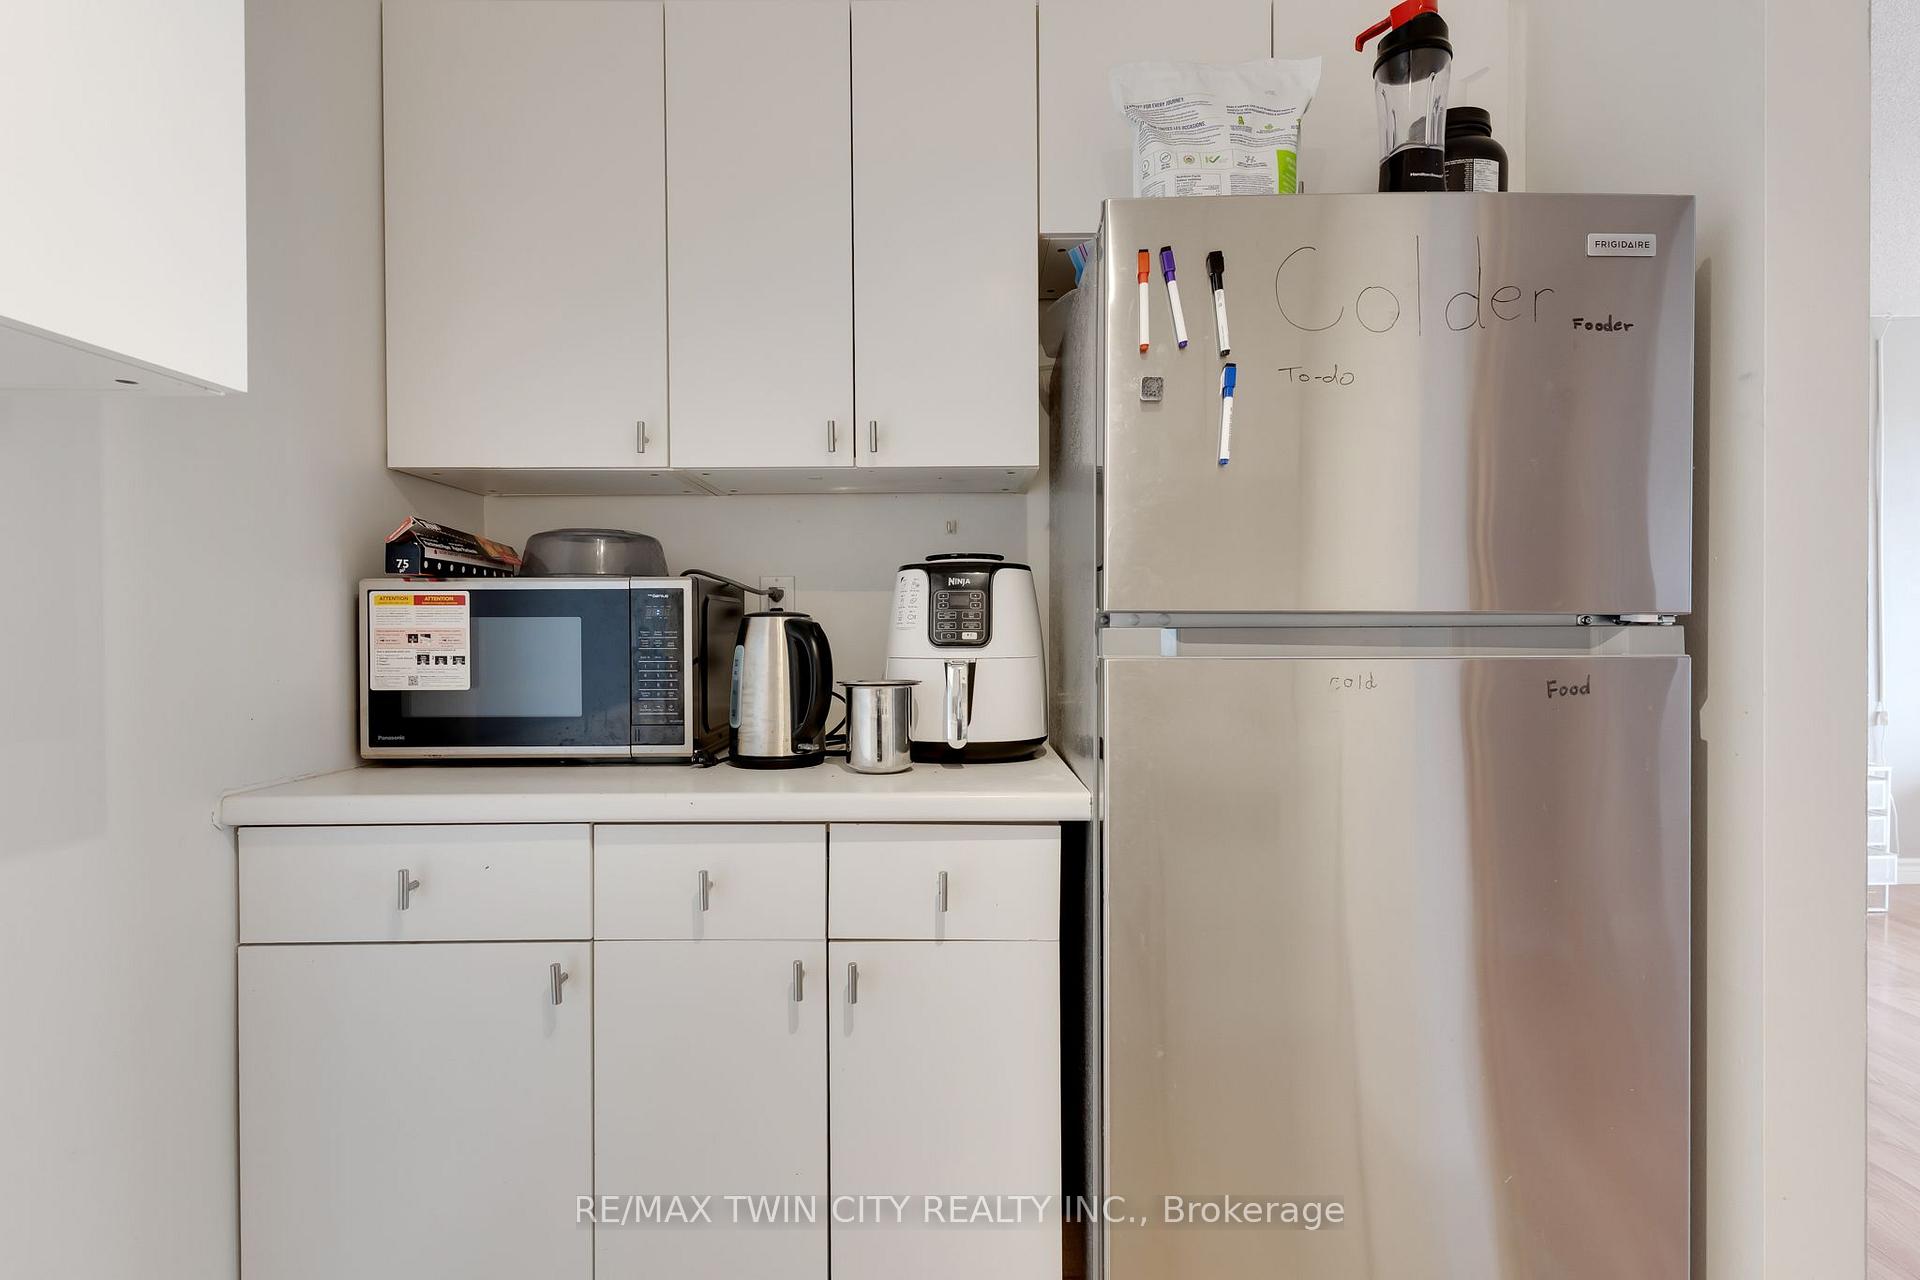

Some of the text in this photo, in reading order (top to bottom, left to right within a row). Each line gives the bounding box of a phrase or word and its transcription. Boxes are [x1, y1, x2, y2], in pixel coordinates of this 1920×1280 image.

[1595, 240, 1650, 249] FRIGIDAIRE
[1275, 234, 1554, 336] Colder
[1572, 314, 1634, 333] Fooder
[1278, 364, 1355, 386] To-do
[396, 558, 410, 569] 75
[1547, 674, 1591, 698] Food
